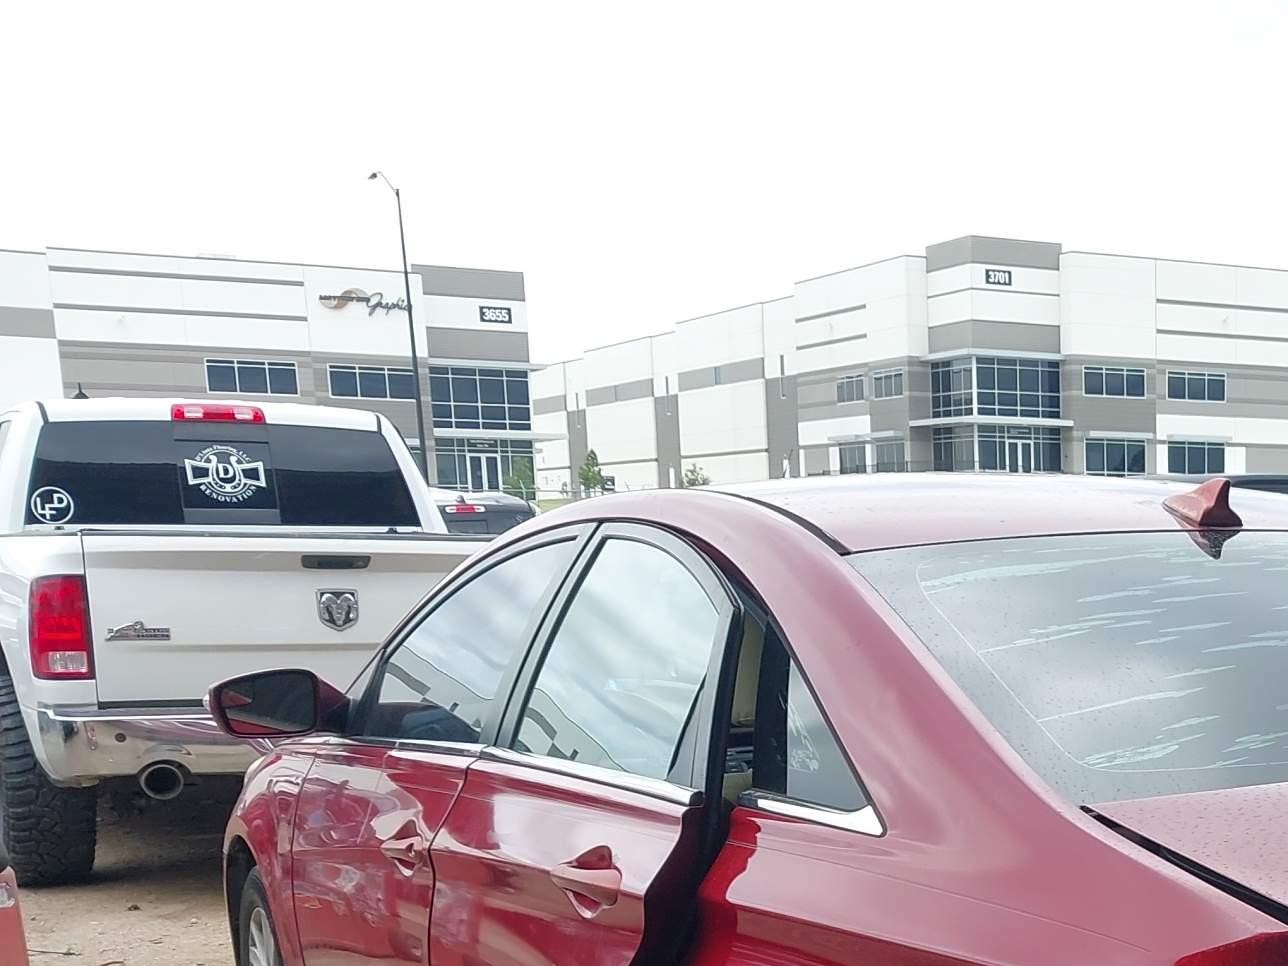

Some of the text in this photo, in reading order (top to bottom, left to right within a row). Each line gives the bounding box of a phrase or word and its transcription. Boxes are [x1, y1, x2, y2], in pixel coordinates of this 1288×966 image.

[988, 271, 1009, 284] 3701
[366, 291, 412, 316] Graphic
[482, 308, 509, 321] 3655
[218, 463, 235, 478] D
[200, 483, 257, 502] RENOVATION
